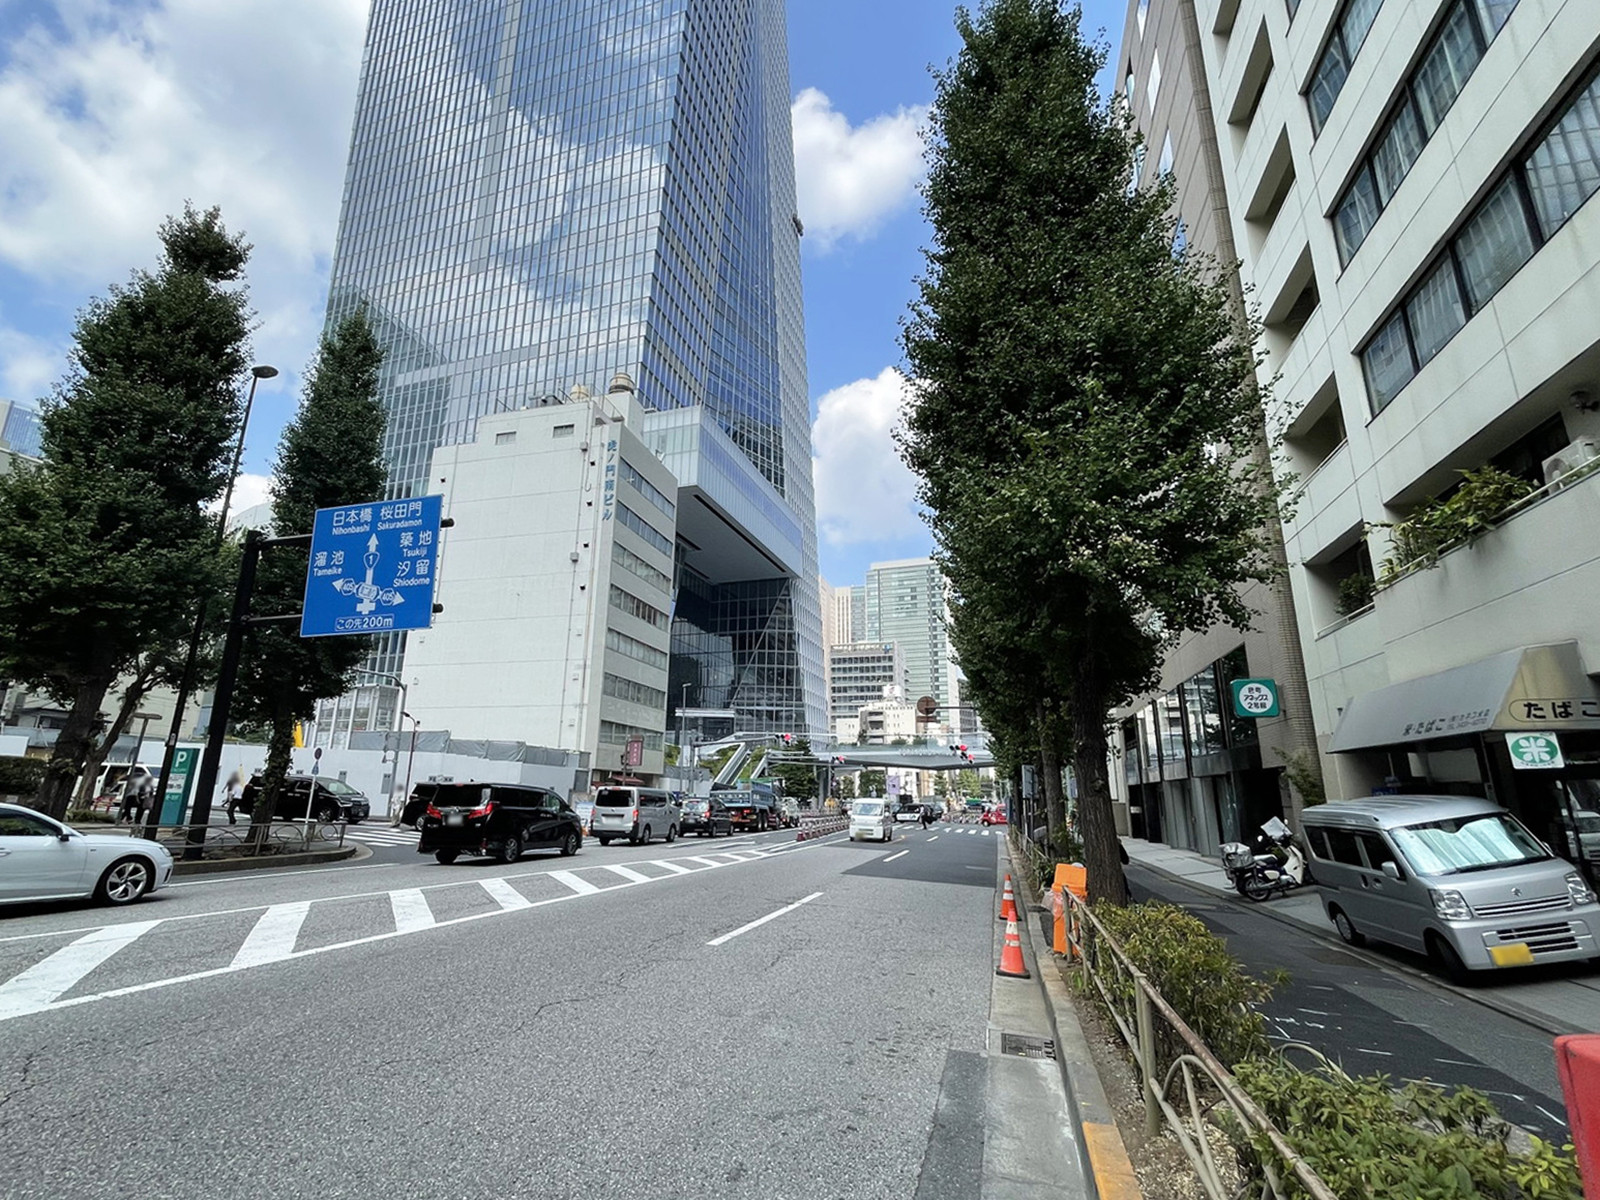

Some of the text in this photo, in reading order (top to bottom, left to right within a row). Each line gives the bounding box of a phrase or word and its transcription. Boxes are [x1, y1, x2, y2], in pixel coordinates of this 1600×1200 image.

[332, 501, 422, 526] 日本橋 桜田門
[332, 518, 423, 536] Nihonbashi Sakuradamon
[400, 530, 432, 548] 築地
[313, 550, 345, 567] 溜池
[368, 555, 374, 565] 1
[402, 547, 428, 558] Tsukiji
[313, 567, 343, 577] Tameike
[397, 559, 430, 577] 汐留
[393, 577, 431, 588] Shiodome
[336, 616, 393, 630] この先200m
[1523, 701, 1600, 719] たばこ
[175, 751, 187, 767] P
